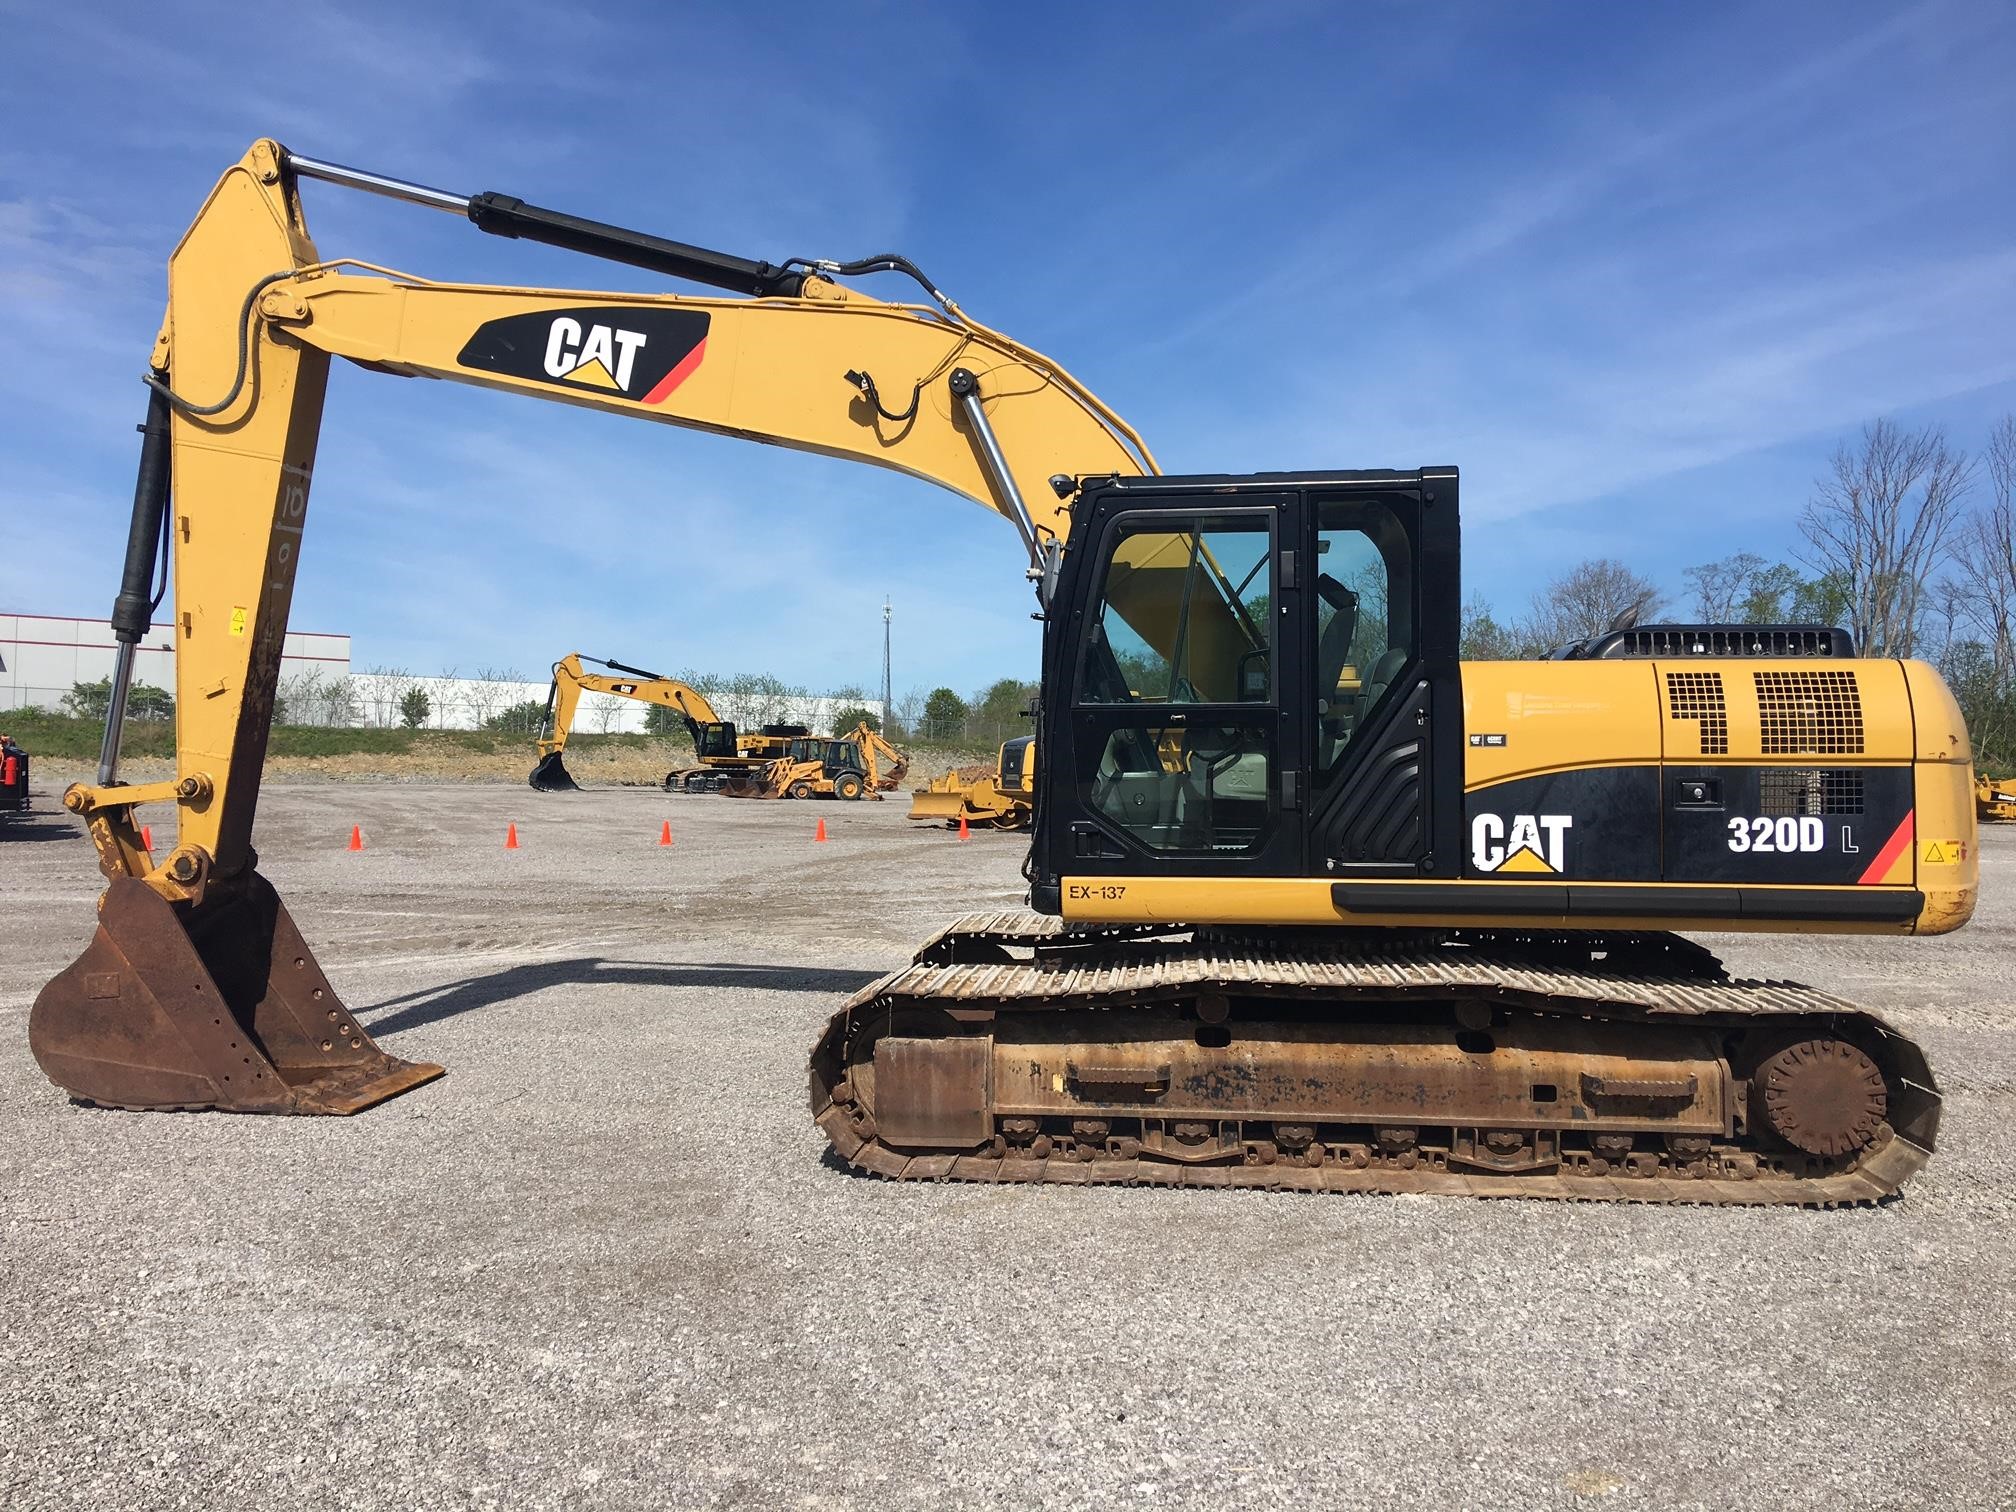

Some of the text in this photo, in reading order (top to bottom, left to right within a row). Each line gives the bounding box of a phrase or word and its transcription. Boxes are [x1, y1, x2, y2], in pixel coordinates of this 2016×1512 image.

[543, 316, 647, 392] CAT
[1471, 813, 1573, 873] CAT
[1727, 816, 1860, 853] 320D L
[1069, 886, 1126, 900] EX-137
